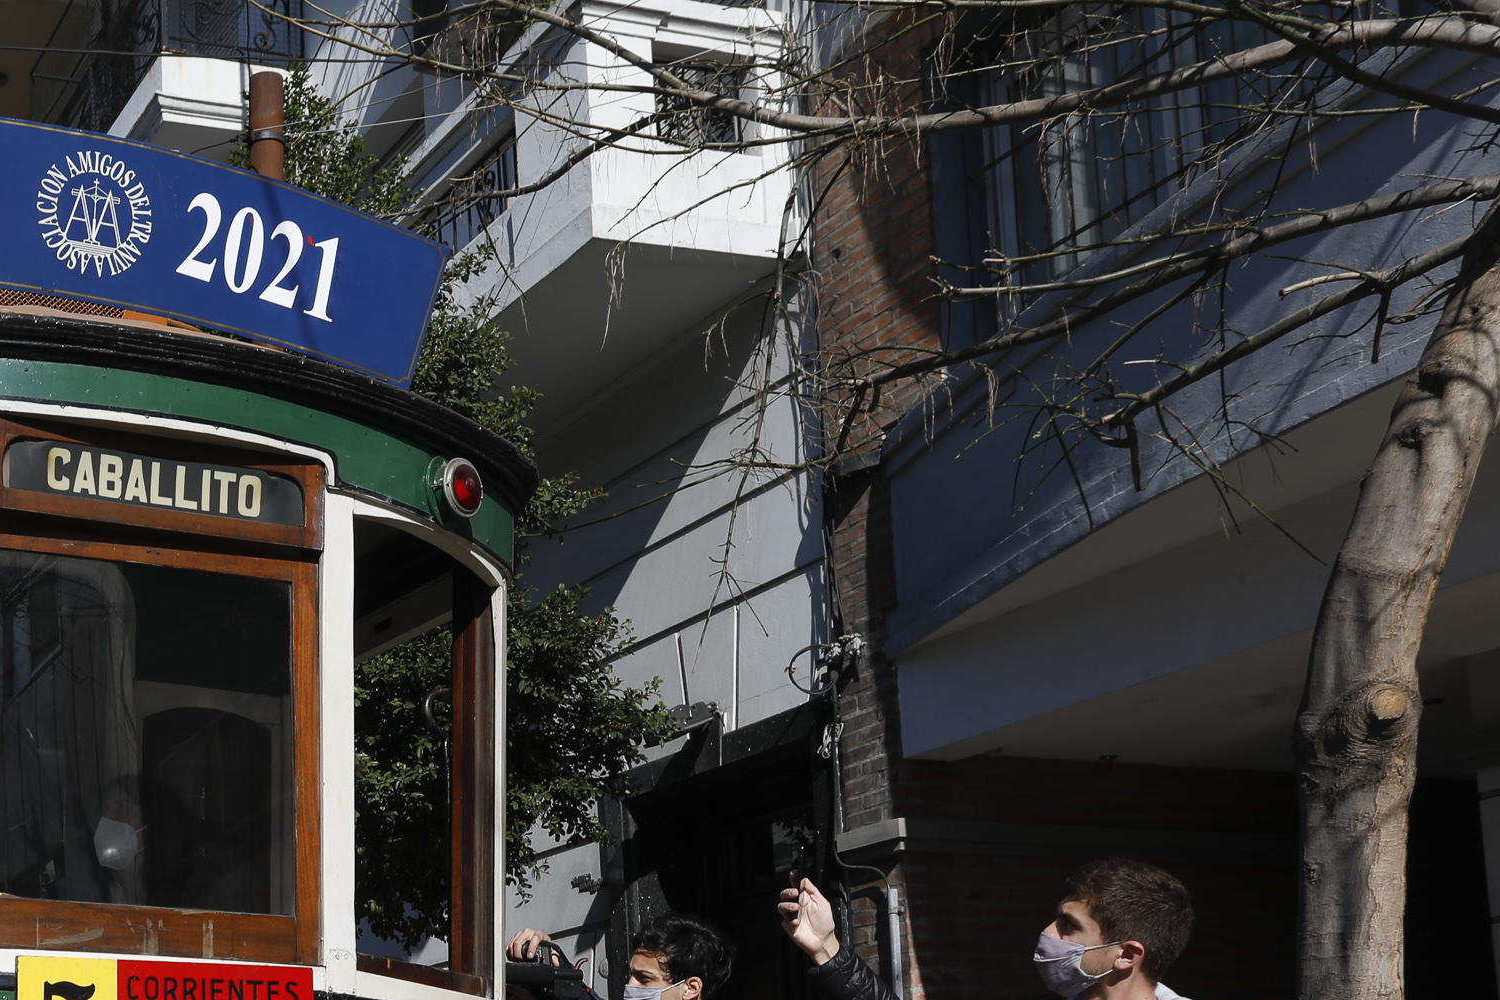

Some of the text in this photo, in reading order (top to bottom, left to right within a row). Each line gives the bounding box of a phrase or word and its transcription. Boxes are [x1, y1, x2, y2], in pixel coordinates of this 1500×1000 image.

[36, 150, 153, 278] ASOCIACION AMIGOS DEL TRANVIA
[175, 192, 339, 323] 2021
[46, 447, 262, 518] CABALLITO
